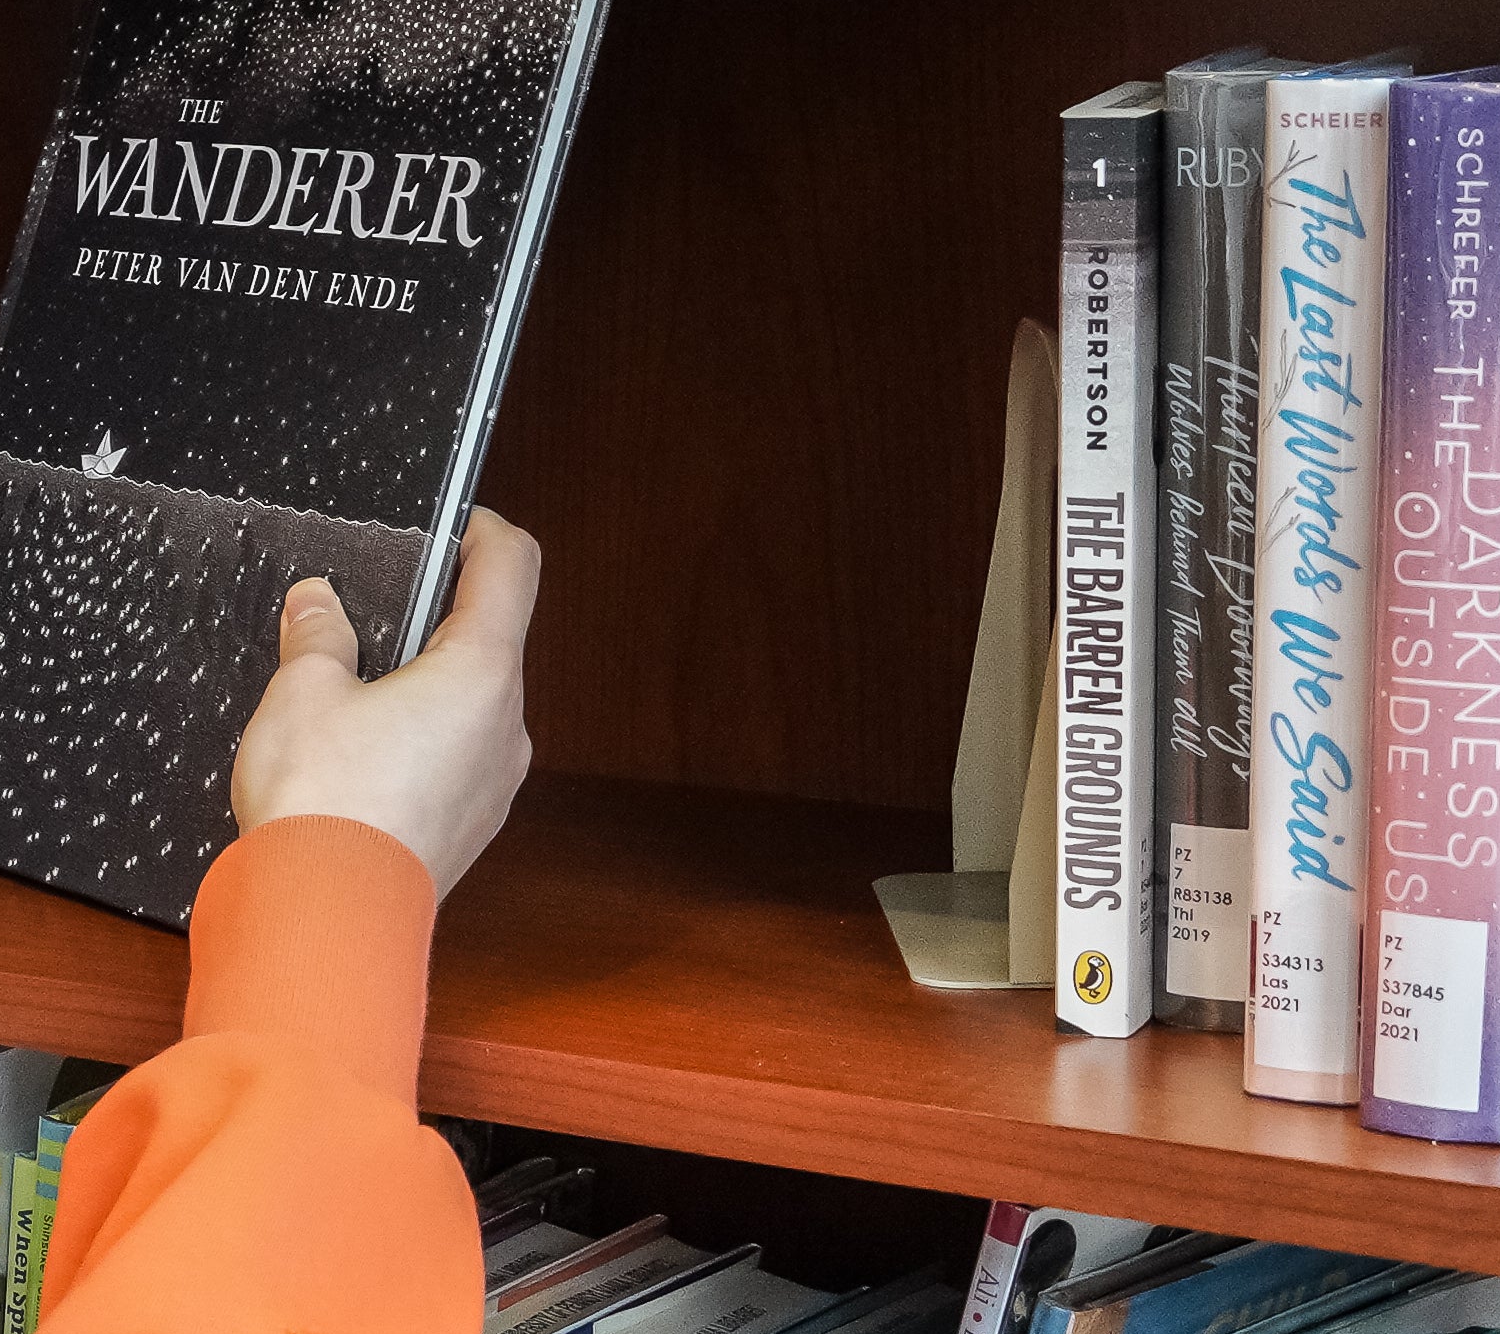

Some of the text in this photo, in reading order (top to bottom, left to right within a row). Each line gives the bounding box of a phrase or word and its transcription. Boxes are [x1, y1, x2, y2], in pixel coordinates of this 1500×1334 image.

[179, 98, 224, 125] THE
[1279, 108, 1385, 130] SCHEIER
[73, 135, 486, 249] WANDERER
[1448, 126, 1490, 321] SCHREFER
[73, 247, 419, 314] PETER VAN DEN ENDE
[1085, 247, 1110, 452] ROBERTSON
[1269, 169, 1366, 892] The Last Words We Said
[1064, 491, 1125, 912] THE BARREN GROUNDS
[1173, 888, 1232, 905] R83138
[1172, 928, 1210, 943] 2019
[1262, 953, 1324, 972] S34313
[1262, 974, 1288, 989] Las
[1382, 983, 1444, 1001] S37845
[1261, 995, 1299, 1012] 2021
[1382, 1002, 1411, 1018] Dar
[1380, 1023, 1419, 1041] 2021
